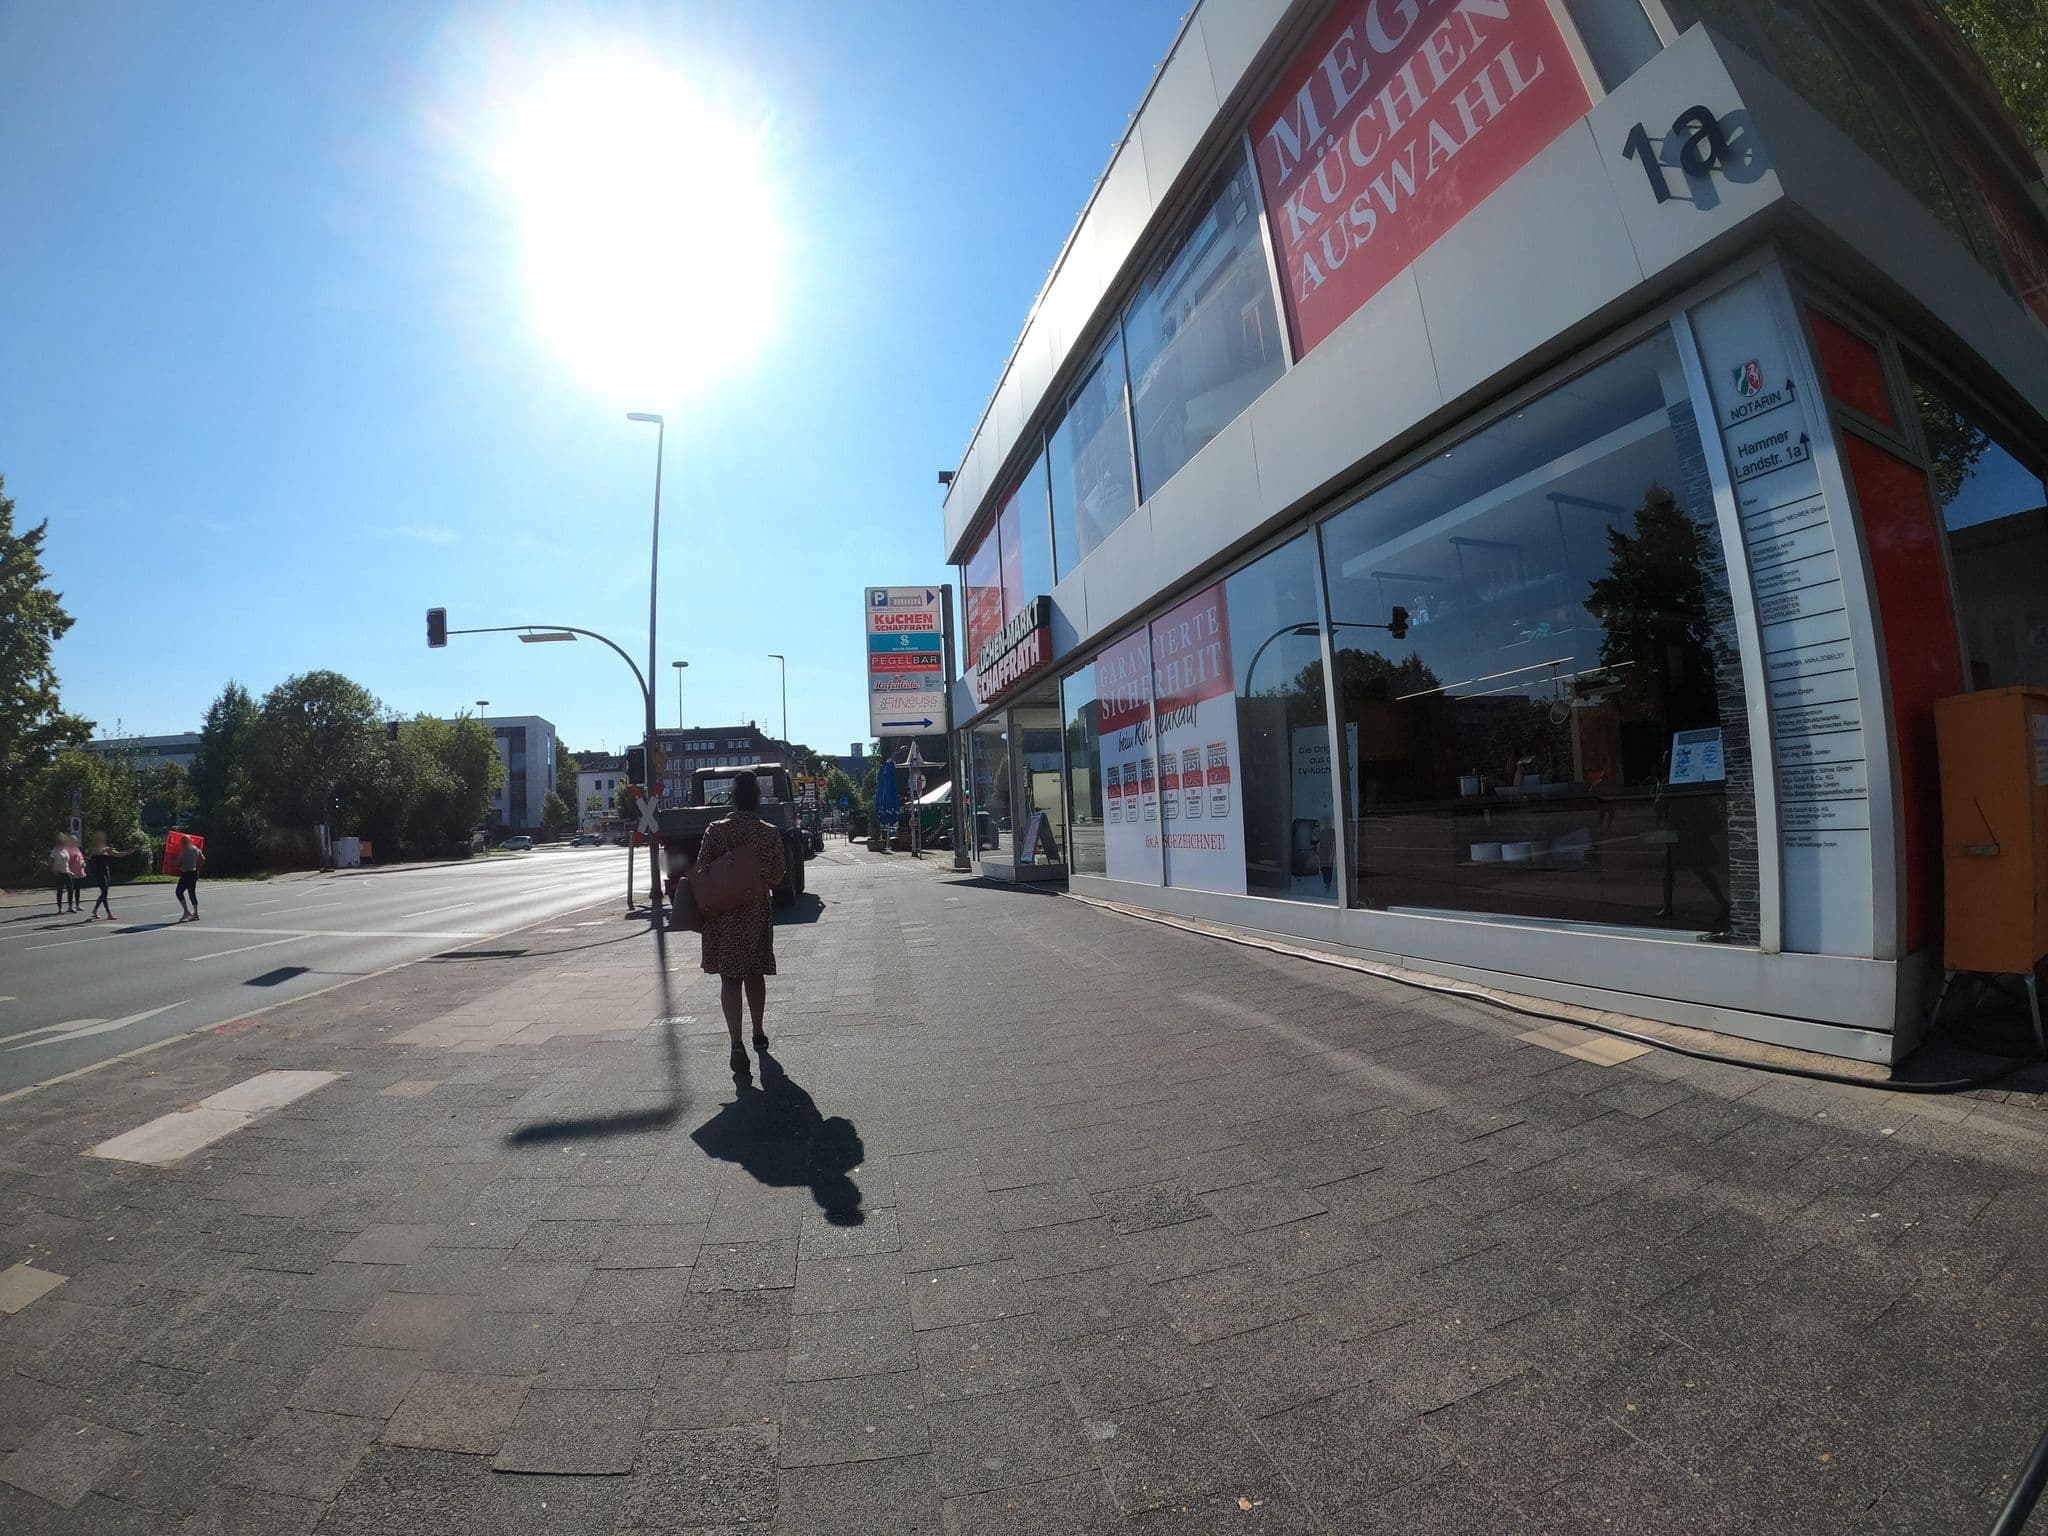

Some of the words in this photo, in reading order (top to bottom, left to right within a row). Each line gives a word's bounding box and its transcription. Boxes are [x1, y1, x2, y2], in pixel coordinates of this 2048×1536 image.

[1267, 0, 1437, 187] MEG
[1282, 0, 1512, 248] KÜCHEN
[1622, 104, 1732, 205] 1a
[1299, 41, 1546, 304] AUSWAHL
[1730, 390, 1781, 420] NOTARIN
[1737, 429, 1790, 459] Hammer
[1735, 448, 1783, 479] Landstr.
[1786, 445, 1803, 467] 1a
[874, 624, 934, 632] SCHAFFRATH
[872, 656, 937, 665] PEGELBAR
[1100, 605, 1220, 688] GARANIERTE
[1183, 757, 1201, 773] TEST
[1208, 751, 1228, 768] TEST
